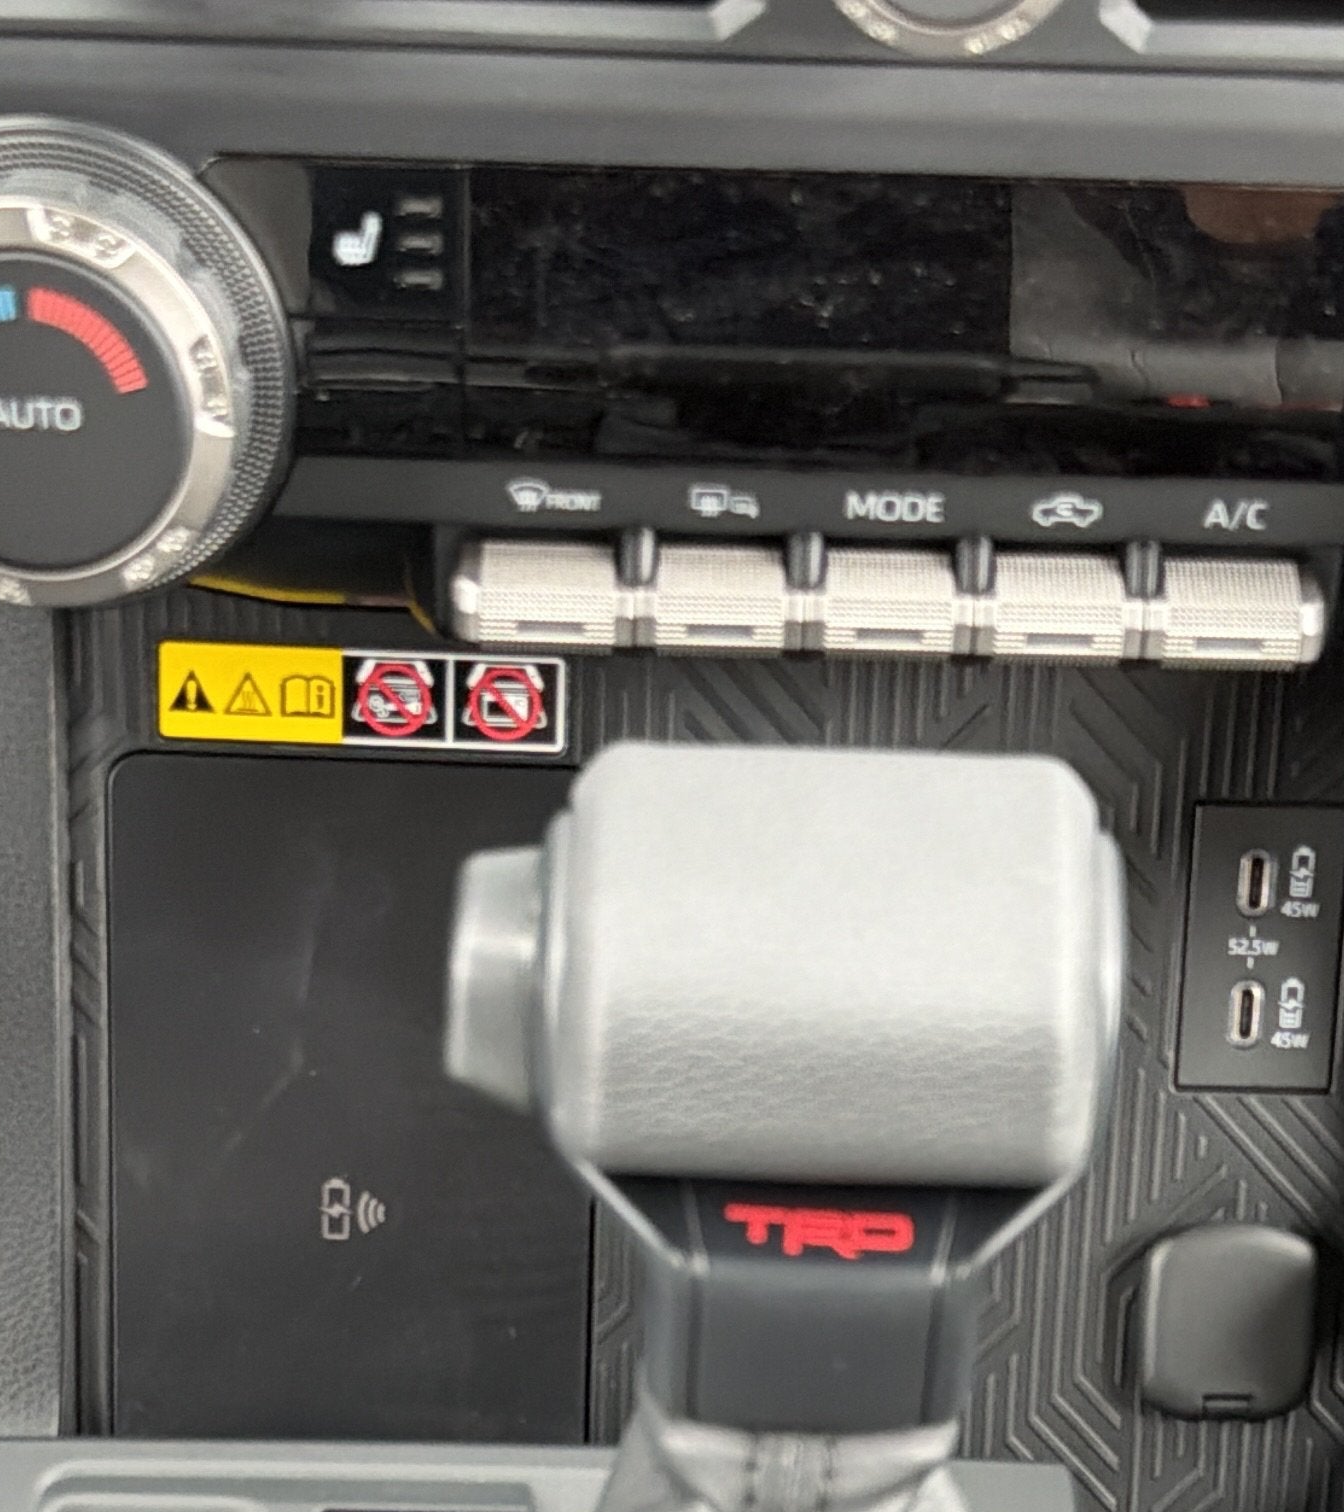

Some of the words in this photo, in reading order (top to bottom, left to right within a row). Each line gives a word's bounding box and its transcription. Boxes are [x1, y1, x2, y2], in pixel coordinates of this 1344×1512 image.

[847, 492, 946, 526] MODE
[1203, 497, 1268, 535] A/C
[1280, 901, 1320, 918] 45W
[1270, 1031, 1310, 1049] 45W
[724, 1202, 915, 1260] TRD
